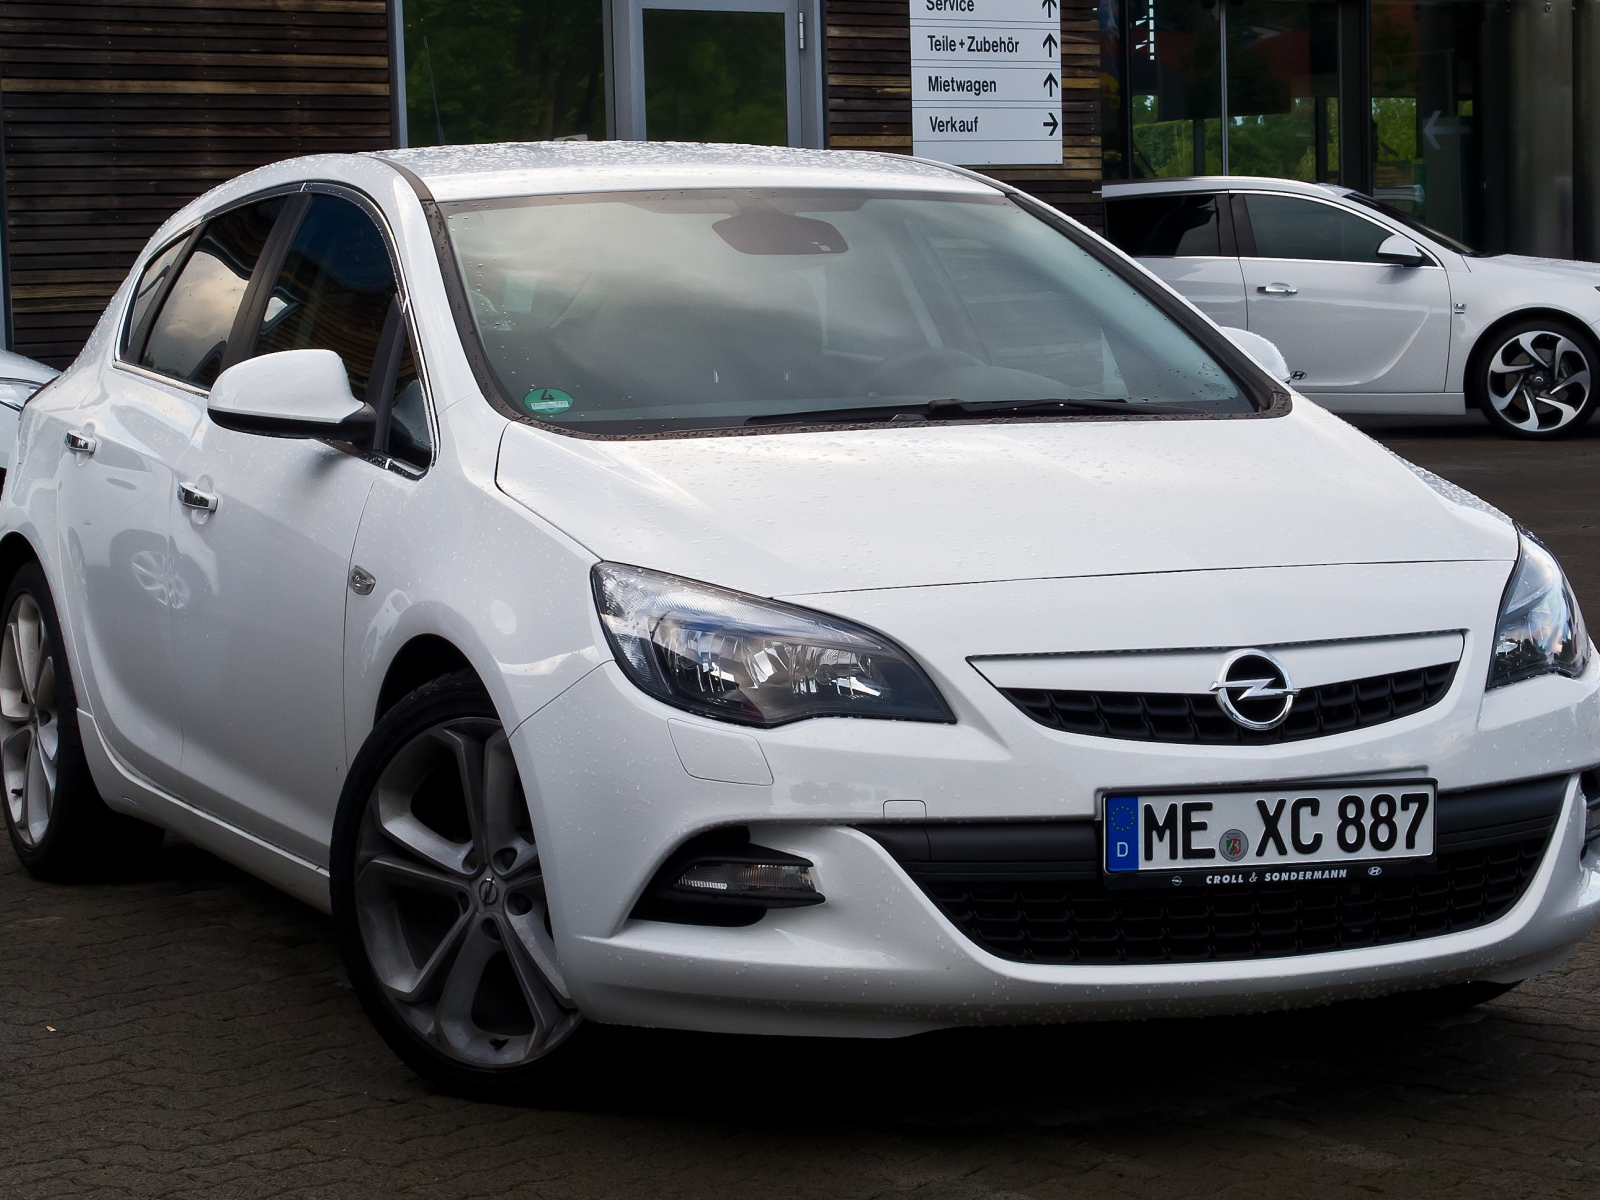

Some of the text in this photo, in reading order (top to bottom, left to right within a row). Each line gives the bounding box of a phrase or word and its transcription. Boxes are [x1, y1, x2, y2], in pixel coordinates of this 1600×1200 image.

[926, 0, 975, 12] Service
[928, 76, 997, 96] Mietwagen
[929, 116, 979, 132] Verkauf
[541, 389, 555, 401] 4
[1143, 793, 1430, 861] ME XC 887
[1117, 842, 1128, 857] D
[1206, 869, 1348, 884] CROLL & SONDERMANN
